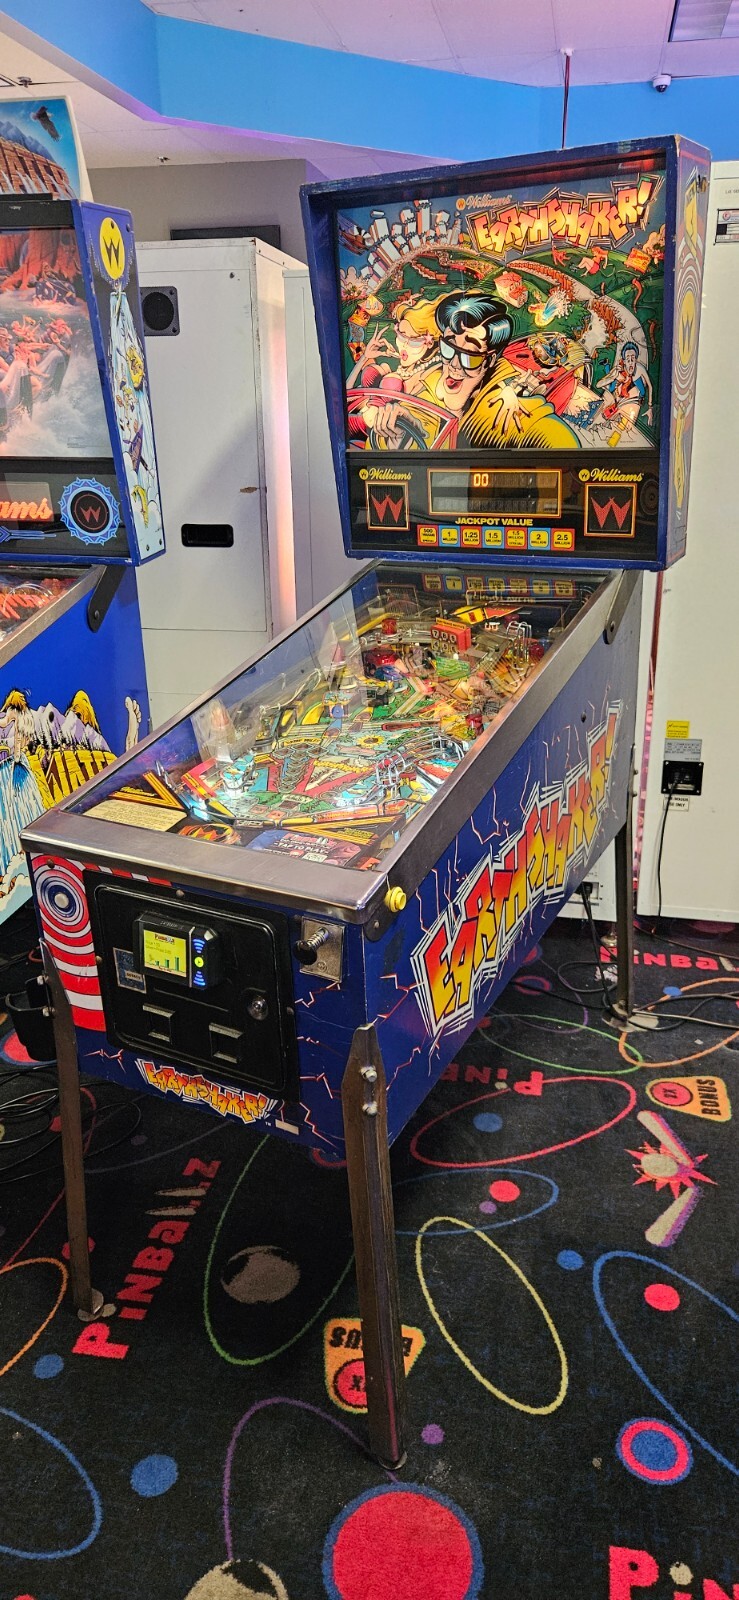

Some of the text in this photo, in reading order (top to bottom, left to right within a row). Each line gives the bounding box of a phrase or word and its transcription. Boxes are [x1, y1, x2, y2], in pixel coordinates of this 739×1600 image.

[474, 180, 653, 253] EARTHSHAKER!
[368, 467, 411, 480] Williams
[590, 467, 643, 482] Williams
[455, 517, 534, 526] JACKPOT VALUE
[424, 712, 618, 1022] EARTHSHAKER!
[143, 1061, 269, 1123] EARTHSHAKER!
[696, 1079, 722, 1116] BONUS
